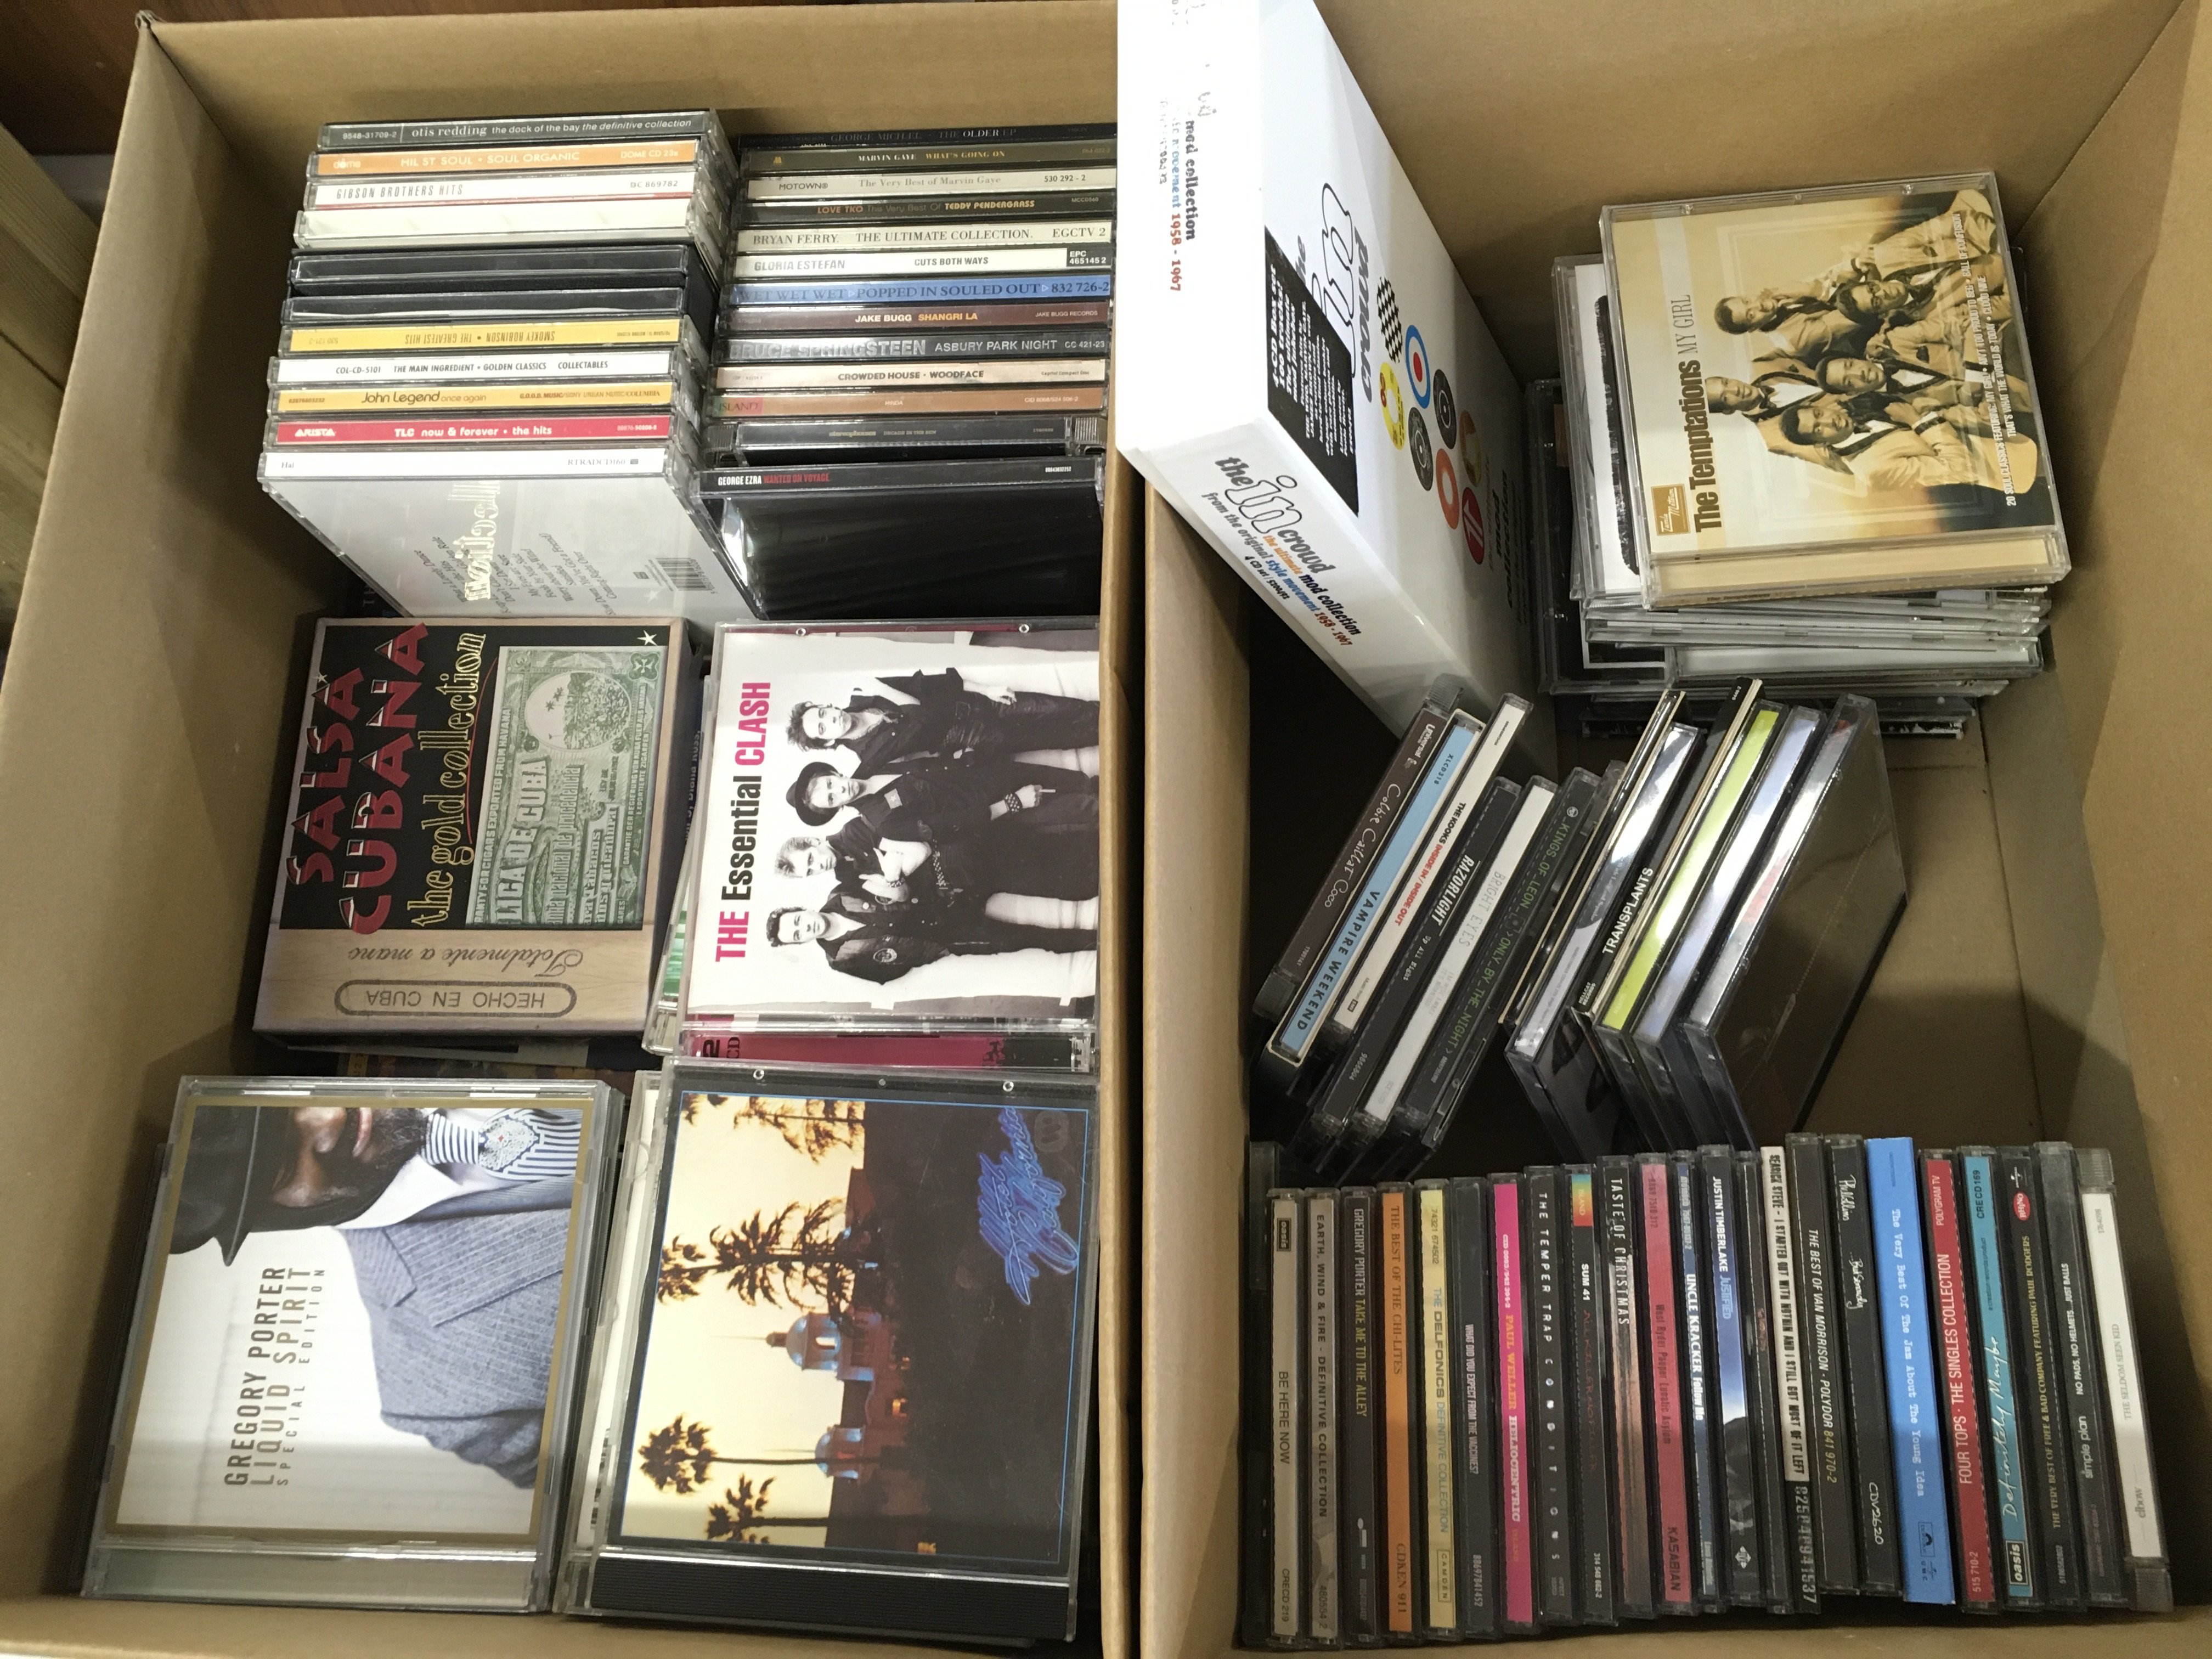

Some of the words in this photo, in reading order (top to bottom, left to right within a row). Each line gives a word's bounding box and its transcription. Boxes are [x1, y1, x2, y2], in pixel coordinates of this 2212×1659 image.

[412, 128, 434, 137] otis
[439, 126, 487, 136] redding
[563, 125, 579, 133] bay
[600, 121, 642, 130] definitive
[645, 120, 691, 128] collection
[1186, 120, 1198, 154] mod
[337, 188, 374, 199] GIBSON
[381, 185, 433, 198] BROTHERS
[439, 185, 462, 195] HITS
[974, 201, 1035, 209] PENDERGRASS
[1185, 159, 1198, 240] collection
[753, 235, 793, 244] BRYAN
[856, 233, 881, 241] THE
[885, 231, 947, 241] ULTIMATE
[1053, 228, 1095, 238] EGCTV
[1099, 228, 1105, 236] 2
[1170, 213, 1181, 245] 1958
[857, 287, 917, 297] POPPED
[921, 286, 937, 296] IN
[940, 285, 1002, 296] SOULED
[1006, 283, 1041, 294] OUT
[1170, 259, 1182, 291] 1967
[1671, 295, 1694, 328] GIRL
[935, 342, 983, 352] ASBURY
[987, 341, 1017, 351] PARK
[1022, 340, 1057, 349] NIGHT
[1675, 334, 1698, 354] MY
[838, 373, 885, 381] CROWDED
[362, 392, 390, 403] John
[393, 391, 440, 404] Legend
[463, 394, 486, 403] again
[394, 428, 414, 437] TLC
[448, 428, 456, 436] &
[460, 427, 499, 436] forever
[512, 426, 529, 435] the
[533, 426, 551, 434] hits
[1678, 360, 1716, 490] Temptations
[718, 477, 743, 486] GEORGE
[745, 476, 761, 484] EZRA
[763, 475, 789, 483] WANTED
[792, 474, 802, 482] ON
[804, 473, 829, 482] VOYAGE
[1215, 456, 1254, 486] the
[1224, 475, 1302, 534] in
[1694, 492, 1722, 532] The
[1278, 529, 1336, 573] crowd
[1262, 535, 1278, 548] the
[1274, 544, 1302, 574] ultimate
[1299, 574, 1328, 594] mod
[1317, 590, 1362, 635] collection
[418, 632, 487, 789] collection
[735, 682, 771, 766] CLASH
[285, 668, 365, 884] SALSA
[338, 623, 428, 934] CUBANA
[1369, 783, 1401, 823] Colbie
[421, 796, 474, 865] gold
[721, 776, 762, 901] Essential
[1344, 828, 1376, 879] Caillat
[407, 870, 453, 927] the
[1325, 879, 1348, 907] Coco
[1430, 854, 1475, 926] RAZORLIGHT
[1482, 871, 1506, 912] BRIGHT
[1338, 891, 1380, 956] VAMPIRE
[1602, 867, 1653, 953] TRANSPLANTS
[715, 911, 749, 962] THE
[1459, 915, 1483, 947] EYES
[348, 947, 413, 961] mano
[421, 948, 435, 961] a
[442, 948, 583, 977] Totalmente
[366, 991, 421, 1007] CUBA
[433, 992, 460, 1007] EN
[473, 992, 545, 1008] HECHO
[1297, 960, 1341, 1030] WEEKEND
[1539, 1193, 1548, 1218] THE
[1611, 1180, 1624, 1217] TASTE
[1713, 1177, 1722, 1209] JUSTIN
[1613, 1225, 1625, 1239] OF
[1892, 1209, 1900, 1227] The
[1316, 1215, 1325, 1259] EARTH,
[1715, 1211, 1728, 1272] TIMBERLAKE
[1809, 1229, 1818, 1247] THE
[1893, 1233, 1903, 1259] Very
[1539, 1229, 1551, 1293] TEMPER
[1581, 1263, 1589, 1286] SUM
[1810, 1250, 1821, 1274] BEST
[1897, 1265, 1906, 1289] Best
[1582, 1288, 1590, 1301] 41
[1615, 1248, 1629, 1325] CHRISTMAS
[1720, 1275, 1733, 1319] JUSTIFIED
[1812, 1278, 1822, 1291] OF
[1937, 1255, 1956, 1325] COLLECTION
[1317, 1301, 1325, 1310] &
[1813, 1294, 1824, 1312] VAN
[1900, 1296, 1909, 1308] Of
[1317, 1316, 1325, 1342] FIRE
[1542, 1304, 1552, 1342] TRAP
[1901, 1315, 1911, 1333] The
[1815, 1315, 1828, 1370] MORRISON
[1903, 1340, 1913, 1359] Jam
[1947, 1329, 1961, 1378] SINGLES
[224, 1372, 267, 1485] GREGORY
[247, 1266, 286, 1358] PORTER
[251, 1384, 291, 1484] LIQUID
[273, 1267, 311, 1363] SPIRIT
[276, 1385, 305, 1485] SPECIAL
[298, 1268, 325, 1364] EDITION
[1278, 1372, 1288, 1387] BE
[1906, 1365, 1916, 1398] About
[1983, 1336, 2007, 1398] Maybe
[1318, 1357, 1327, 1427] DEFINITIVE
[1820, 1380, 1832, 1427] POLYDOR
[1952, 1381, 1962, 1405] THE
[1279, 1392, 1289, 1427] HERE
[1909, 1404, 1918, 1424] The
[1279, 1431, 1289, 1464] NOW
[1824, 1430, 1833, 1448] 841
[1911, 1430, 1921, 1464] Young
[1954, 1416, 1967, 1447] TOPS
[1319, 1434, 1327, 1517] COLLECTION
[1825, 1453, 1836, 1483] 970-2
[1958, 1452, 1972, 1483] FOUR
[1991, 1406, 2018, 1521] Definitely
[1916, 1470, 1925, 1496] Idea
[2011, 1544, 2023, 1581] oasis
